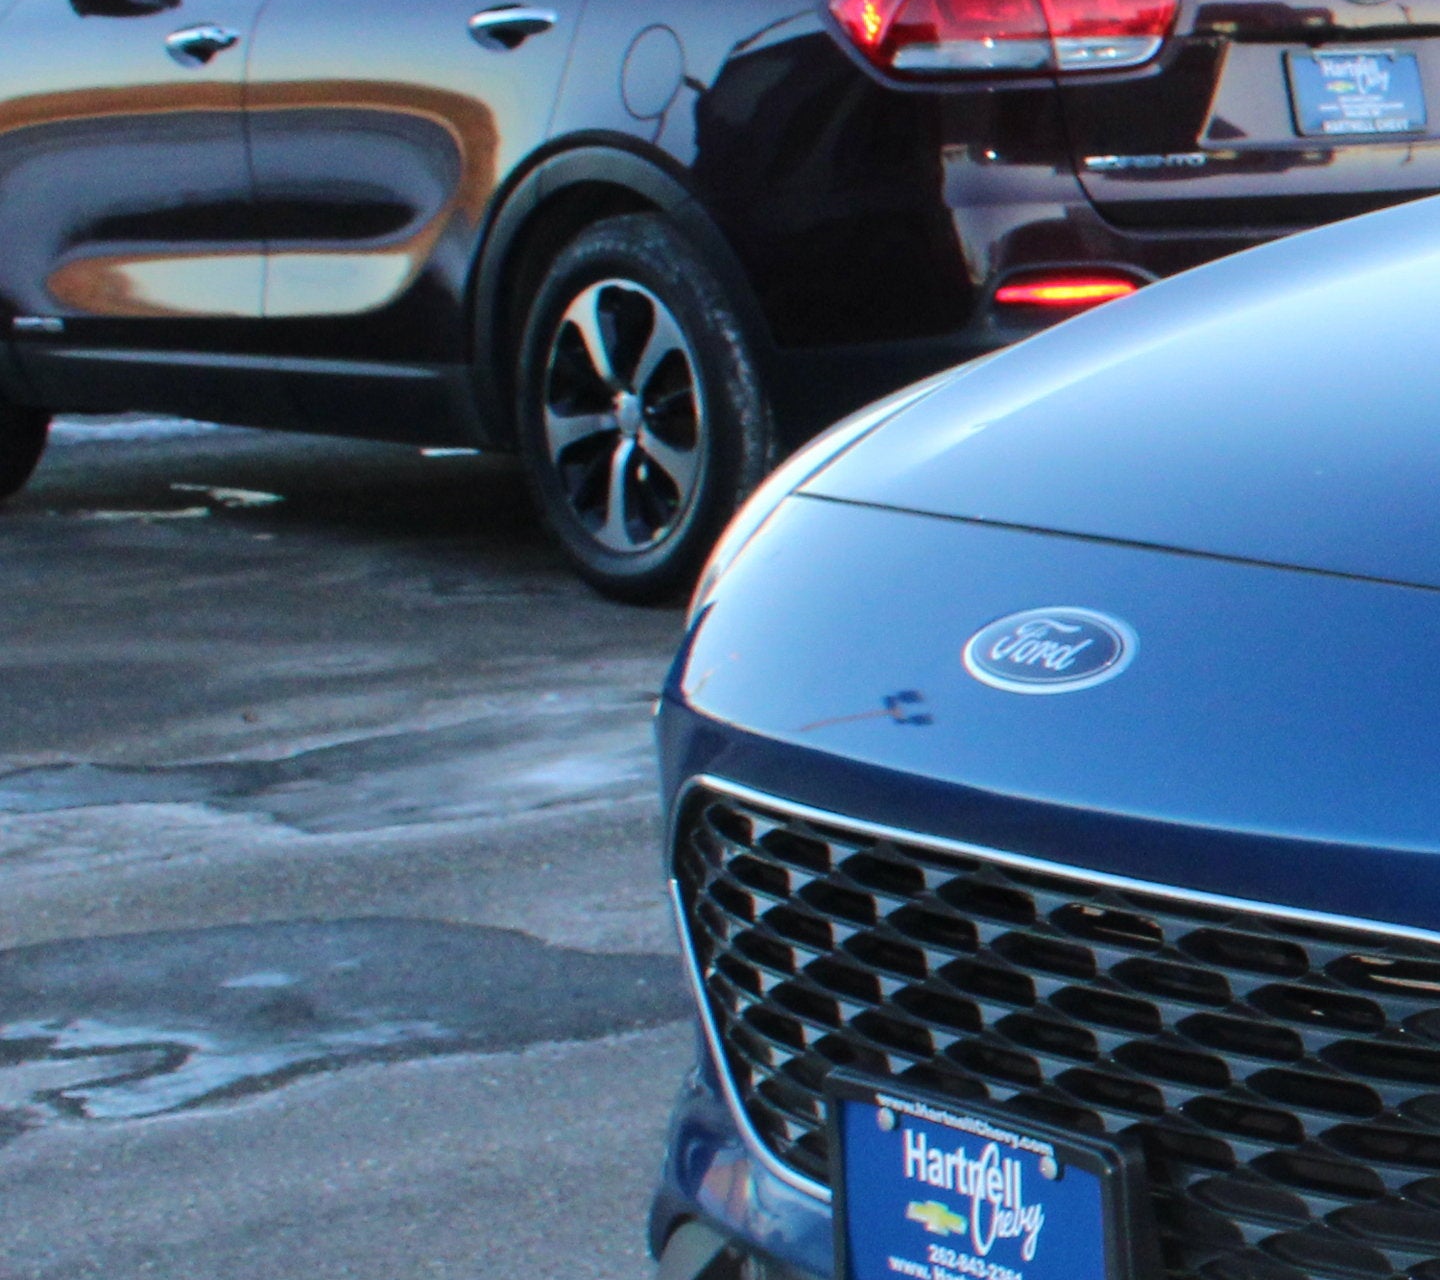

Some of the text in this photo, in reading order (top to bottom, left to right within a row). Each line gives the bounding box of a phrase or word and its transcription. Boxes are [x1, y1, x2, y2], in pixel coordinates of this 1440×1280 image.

[990, 618, 1094, 671] Ford
[904, 1128, 1022, 1209] Hartnell
[971, 1141, 1045, 1261] Chevy
